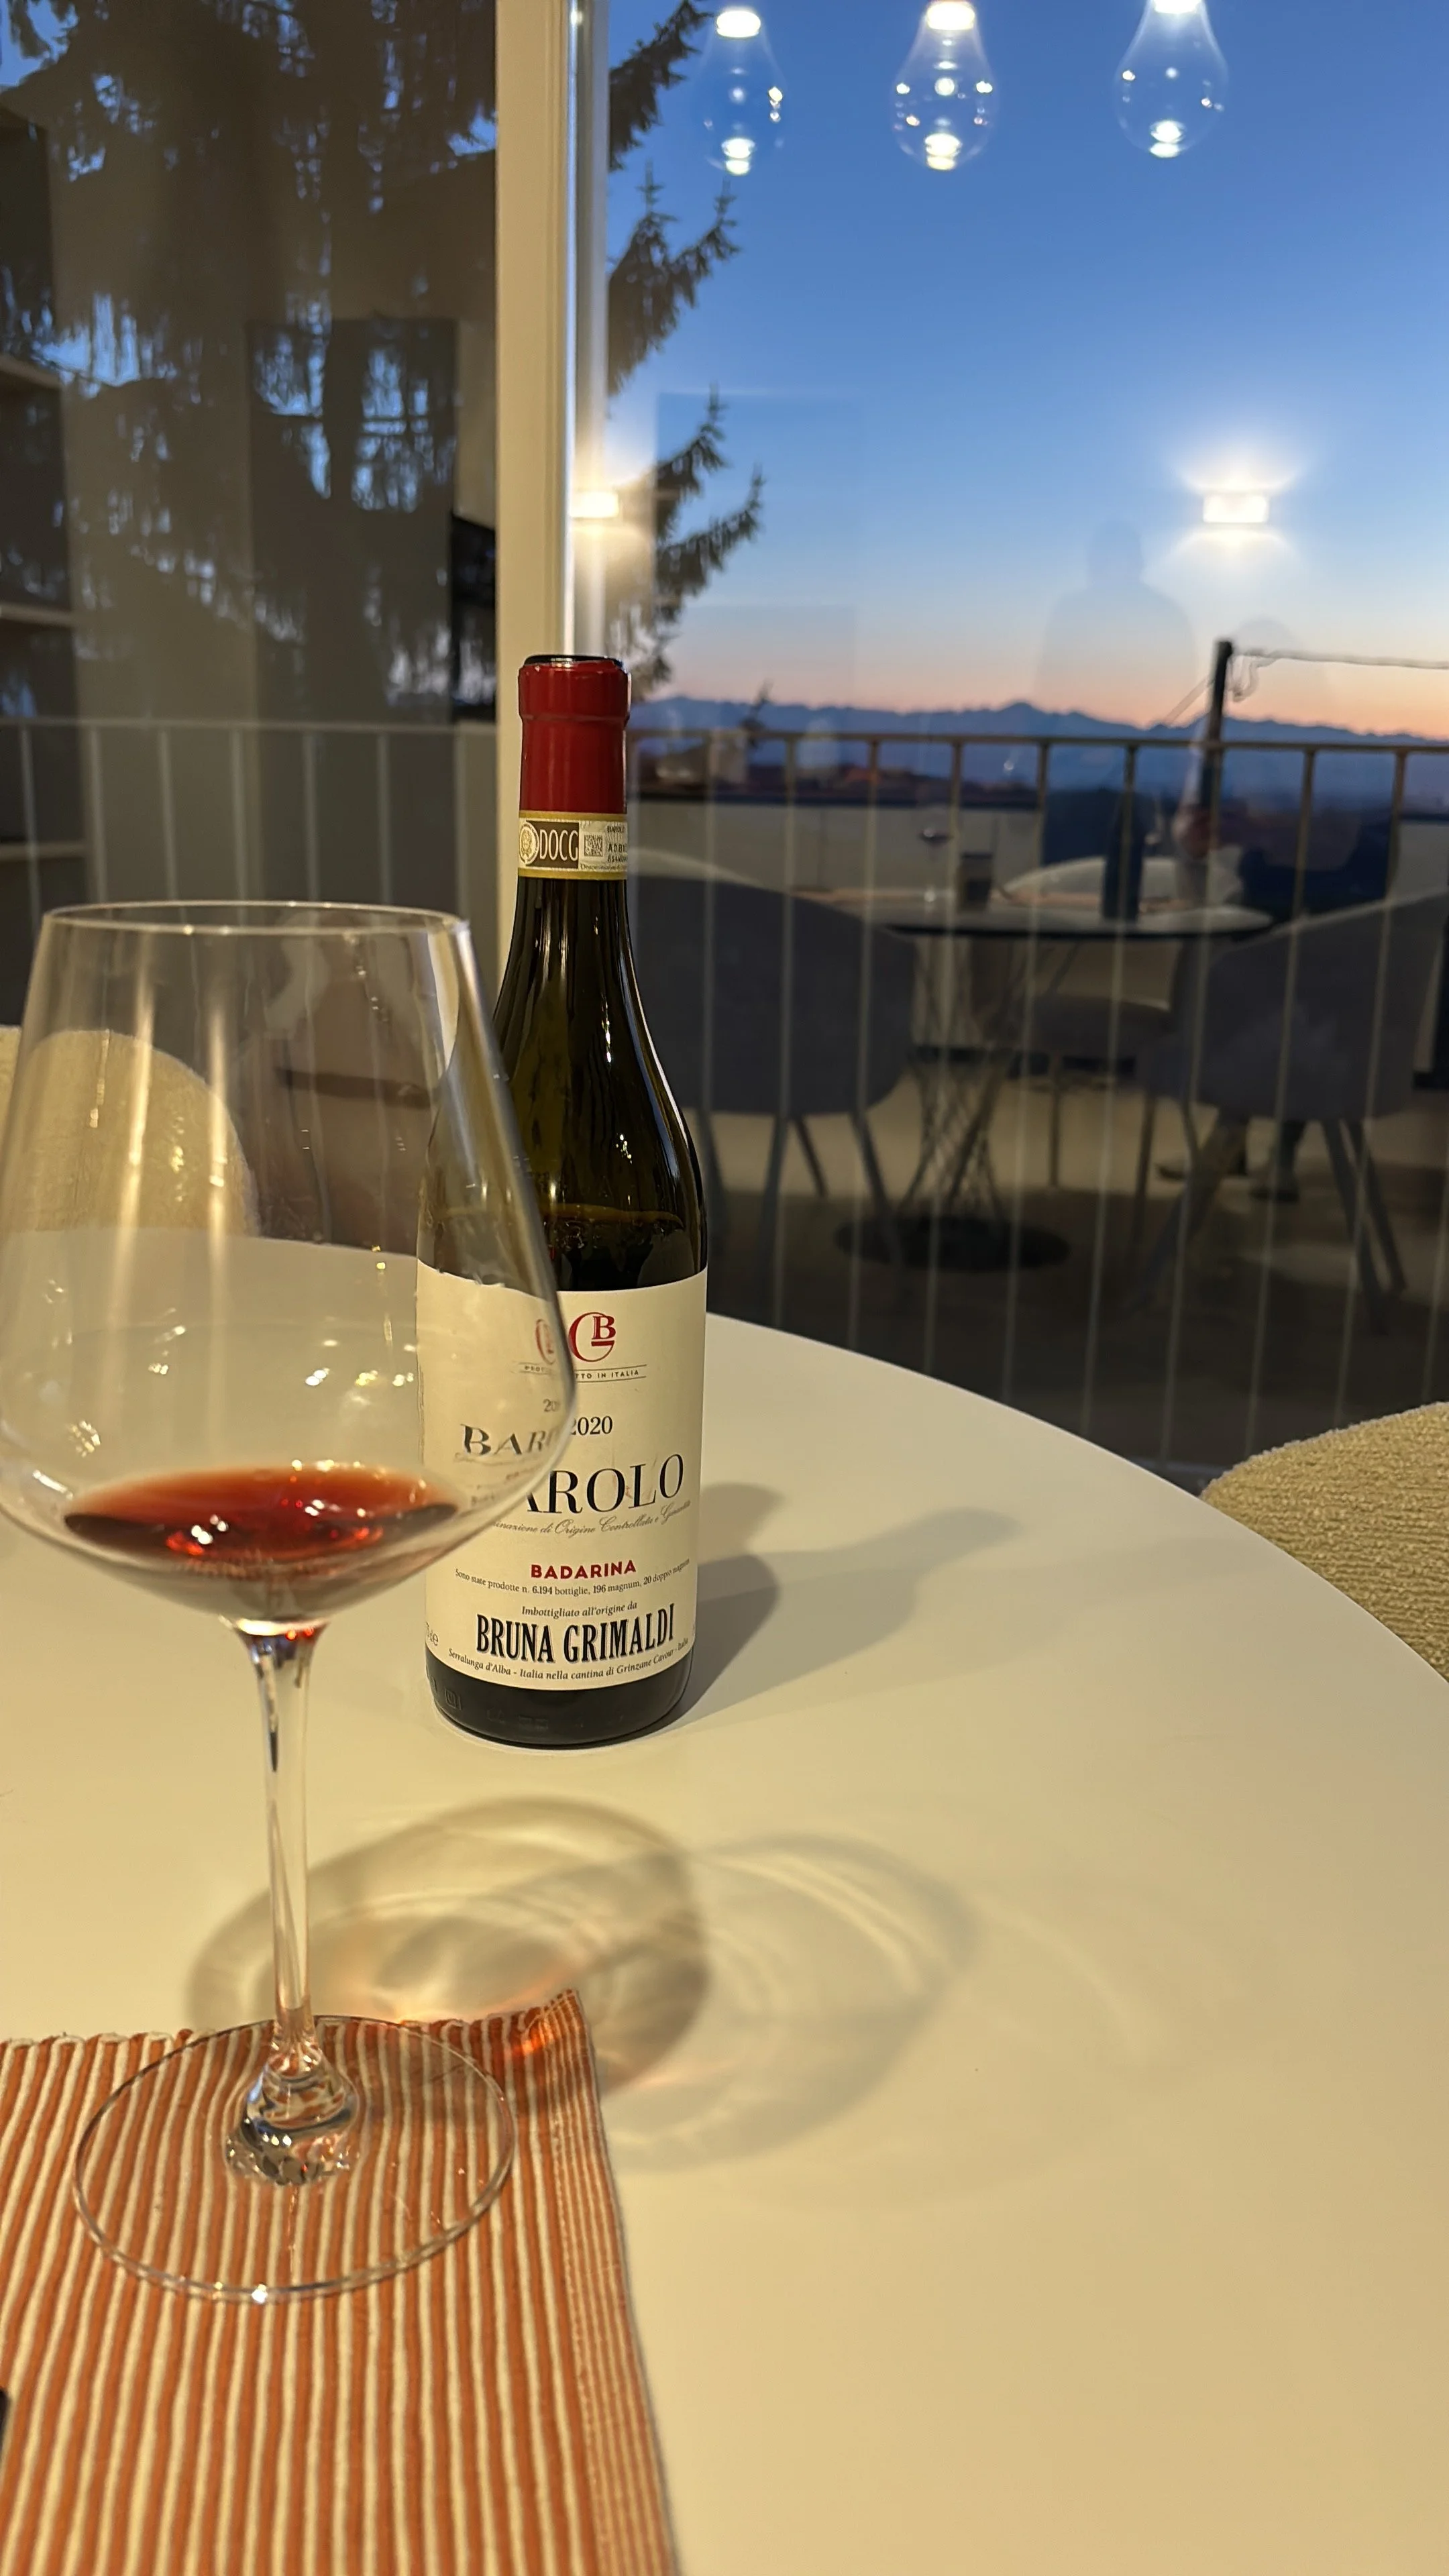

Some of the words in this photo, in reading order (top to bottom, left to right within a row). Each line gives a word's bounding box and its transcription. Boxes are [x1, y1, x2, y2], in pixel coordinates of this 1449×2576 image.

[539, 829, 578, 861] DOCG
[611, 1369, 639, 1378] ITALIA
[554, 1519, 595, 1538] Origine
[531, 1559, 637, 1580] BADARINA
[455, 1568, 470, 1581] Sono
[471, 1576, 486, 1586] state
[488, 1580, 520, 1593] prodotte
[532, 1585, 553, 1595] 6.194
[555, 1585, 591, 1597] bottiglie,
[592, 1585, 606, 1594] 196
[607, 1580, 642, 1593] magnum,
[643, 1576, 652, 1586] 20
[521, 1605, 580, 1619] Imbottigliato
[582, 1605, 625, 1618] all'origine
[627, 1600, 637, 1611] da
[476, 1613, 555, 1663] BRUNA
[564, 1603, 675, 1663] GRIMALDI
[448, 1648, 484, 1670] Serralunga
[485, 1662, 511, 1676] d'Alba
[519, 1668, 543, 1680] Italia
[545, 1670, 568, 1680] nella
[570, 1669, 604, 1680] cantina
[605, 1666, 614, 1676] di
[616, 1660, 652, 1674] Grinzane
[653, 1650, 674, 1665] Cavour
